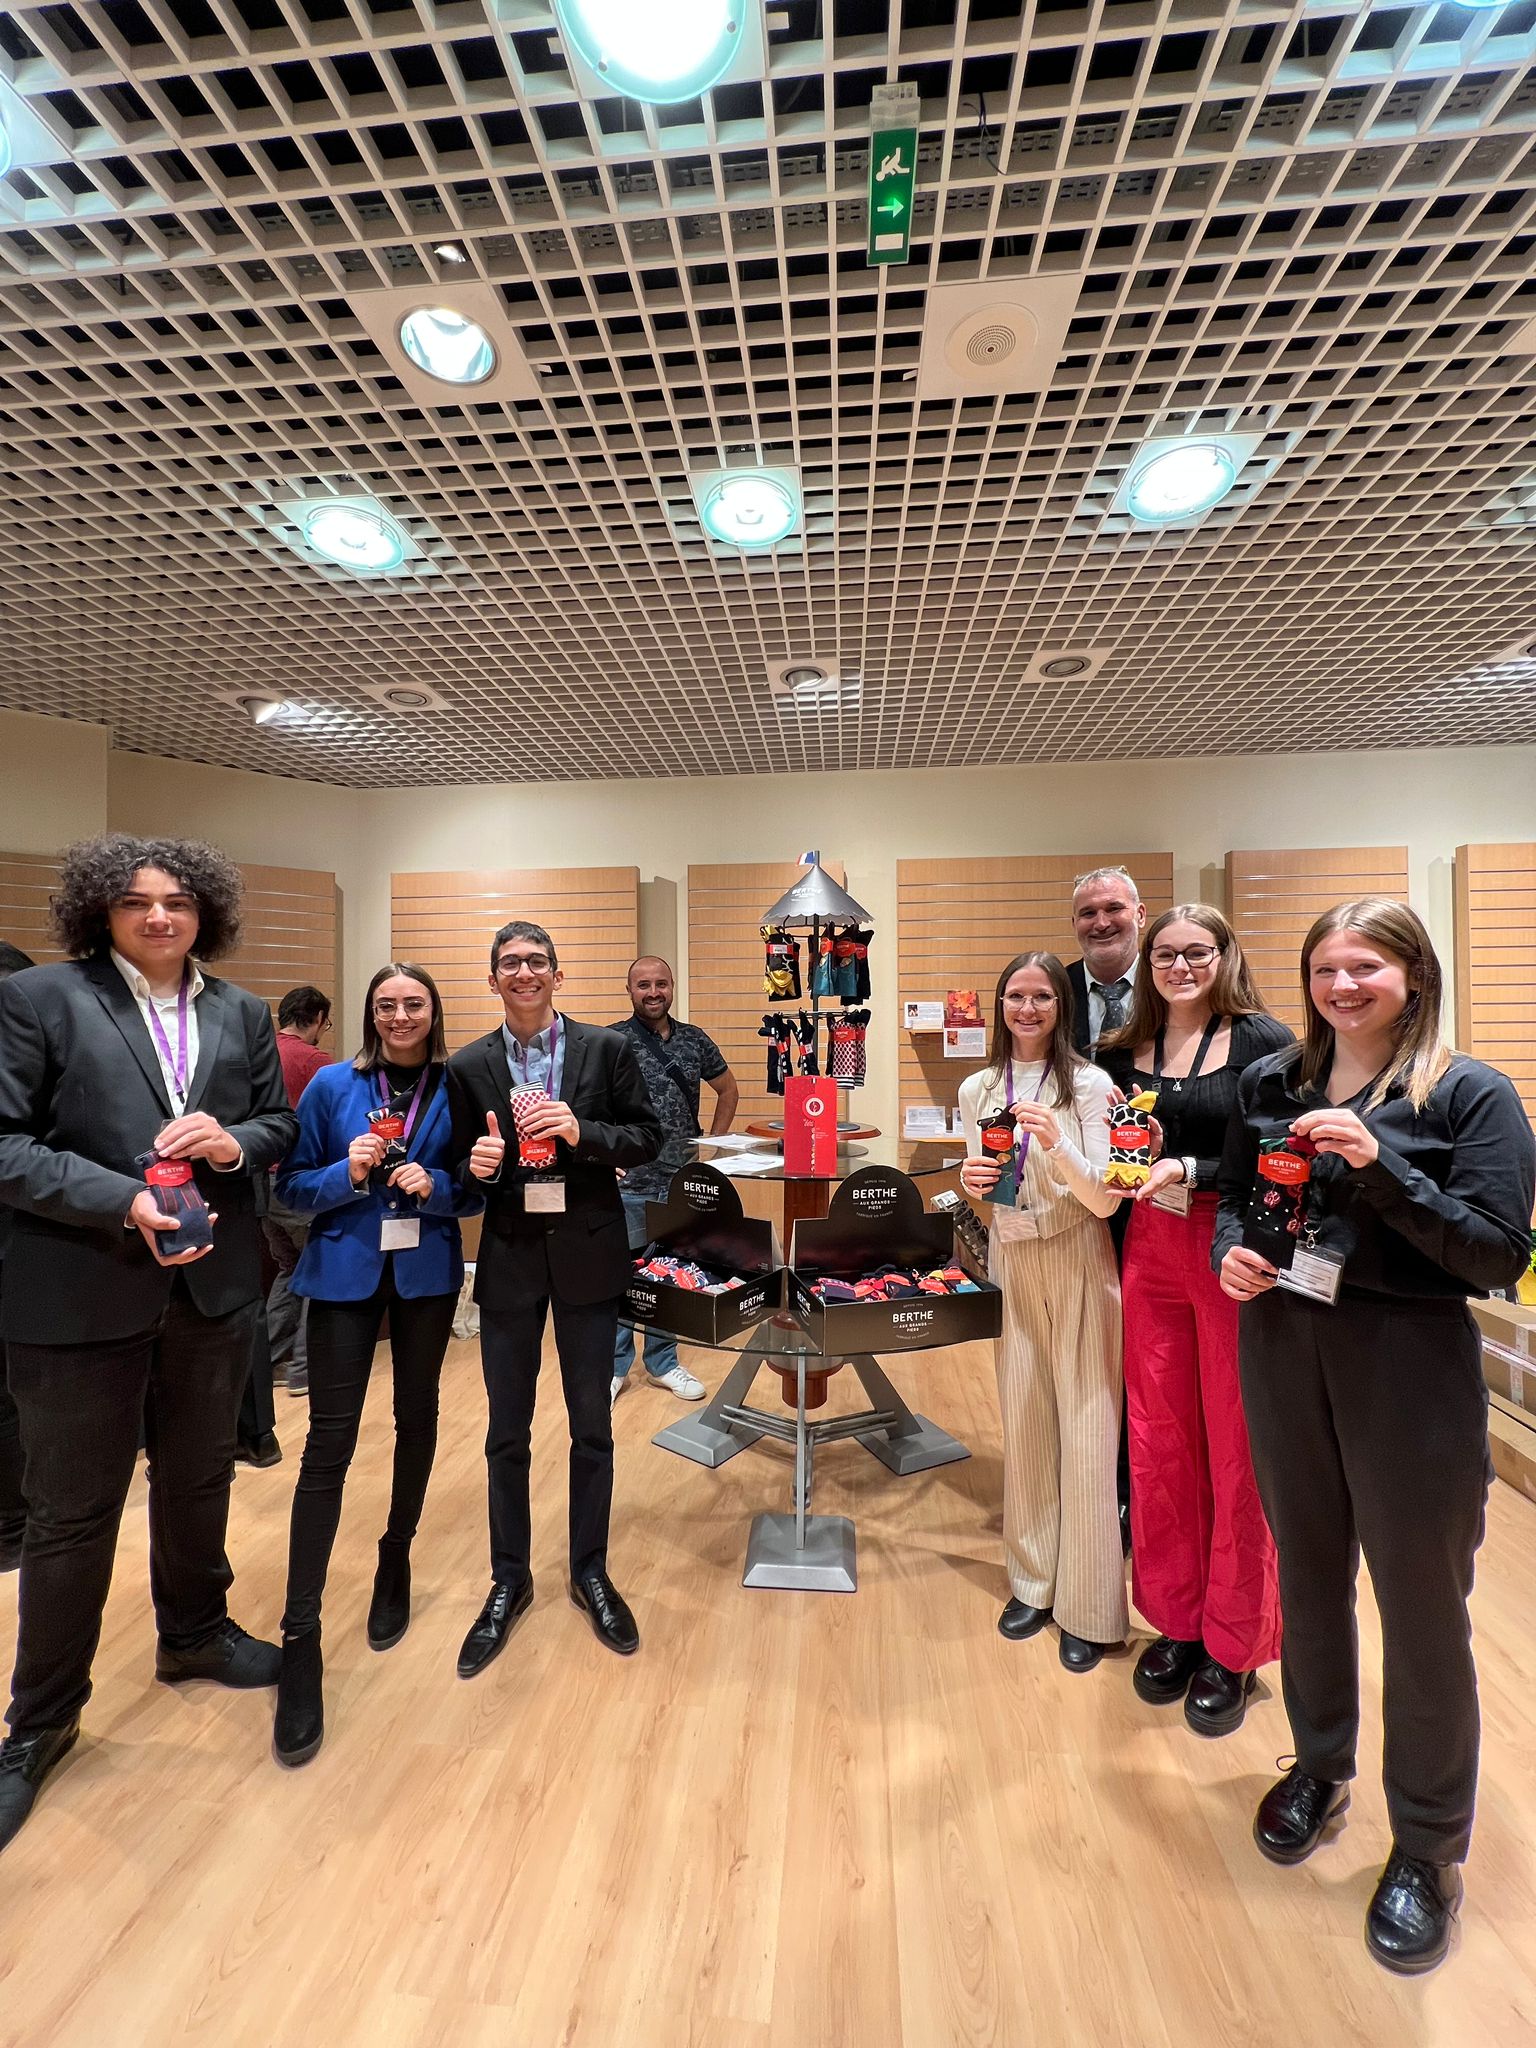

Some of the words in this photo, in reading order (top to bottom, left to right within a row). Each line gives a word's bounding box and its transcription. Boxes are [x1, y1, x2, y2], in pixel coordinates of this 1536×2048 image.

[526, 1147, 548, 1155] BERTHE
[157, 1165, 185, 1176] BERTHE
[1267, 1158, 1302, 1170] BERTHE
[683, 1181, 720, 1196] BERTHE
[852, 1187, 898, 1200] BERTHE
[626, 1289, 657, 1304] BERTHE
[739, 1291, 766, 1311] BERTHE
[796, 1290, 811, 1313] BERTHE
[892, 1310, 934, 1323] BERTHE
